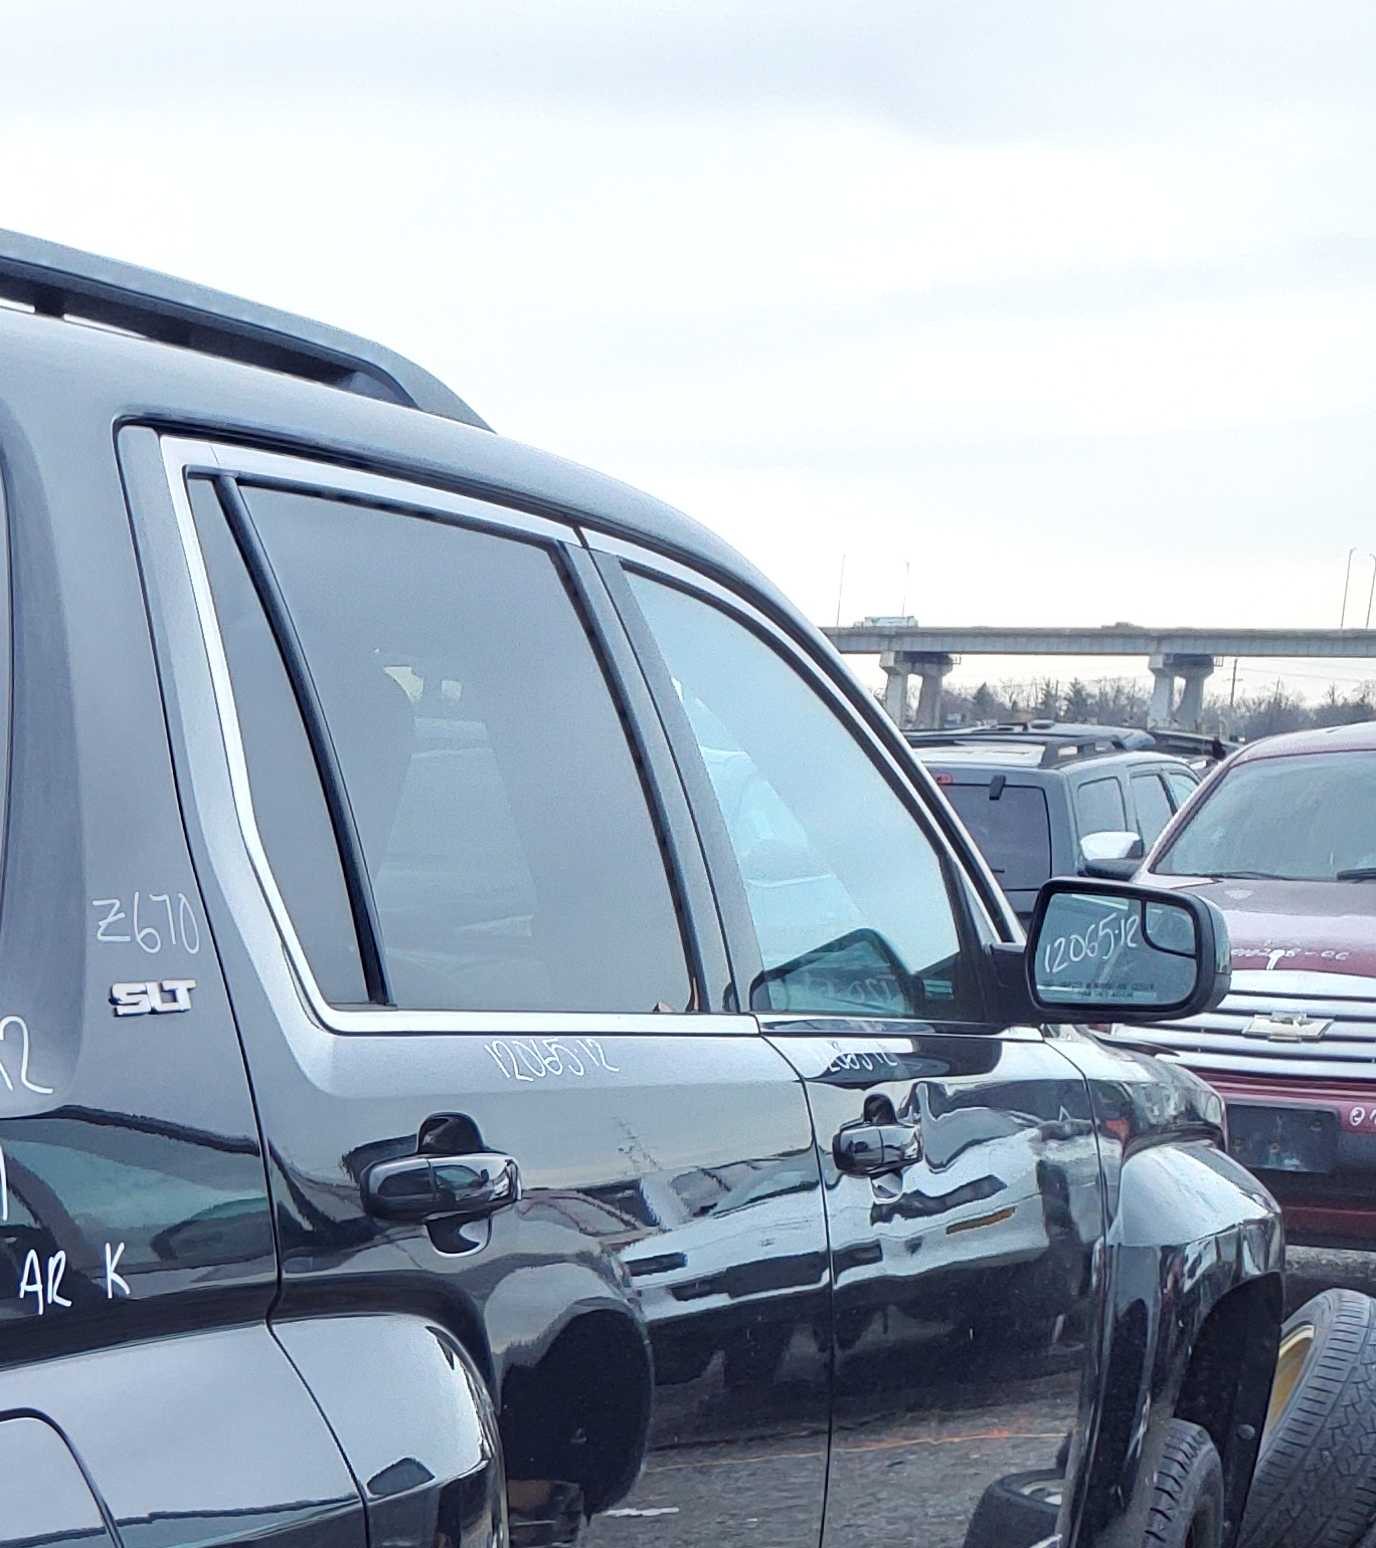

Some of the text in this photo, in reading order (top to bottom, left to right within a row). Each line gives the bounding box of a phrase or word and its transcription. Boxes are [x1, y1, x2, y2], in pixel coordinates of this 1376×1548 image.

[92, 891, 200, 954] Z670
[108, 979, 197, 1017] SLT
[19, 1248, 72, 1315] AR
[104, 1241, 132, 1300] K
